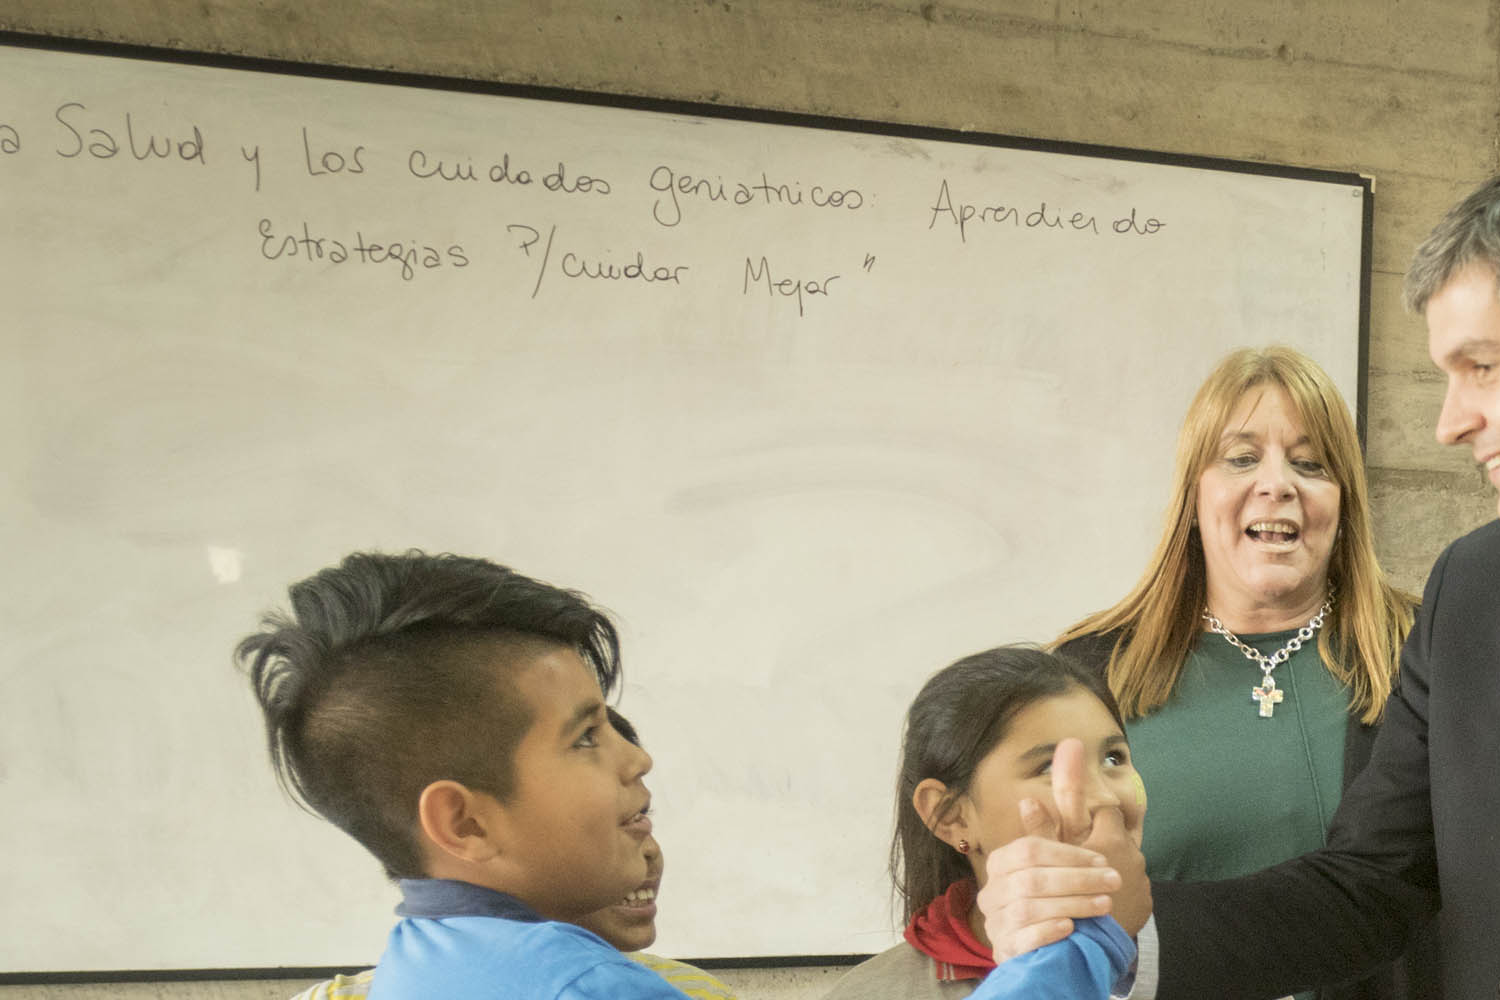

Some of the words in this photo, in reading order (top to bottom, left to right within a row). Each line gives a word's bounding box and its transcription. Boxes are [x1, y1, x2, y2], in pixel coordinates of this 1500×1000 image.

[55, 102, 206, 165] Salud
[241, 146, 262, 191] y
[258, 219, 470, 281] Estrategias
